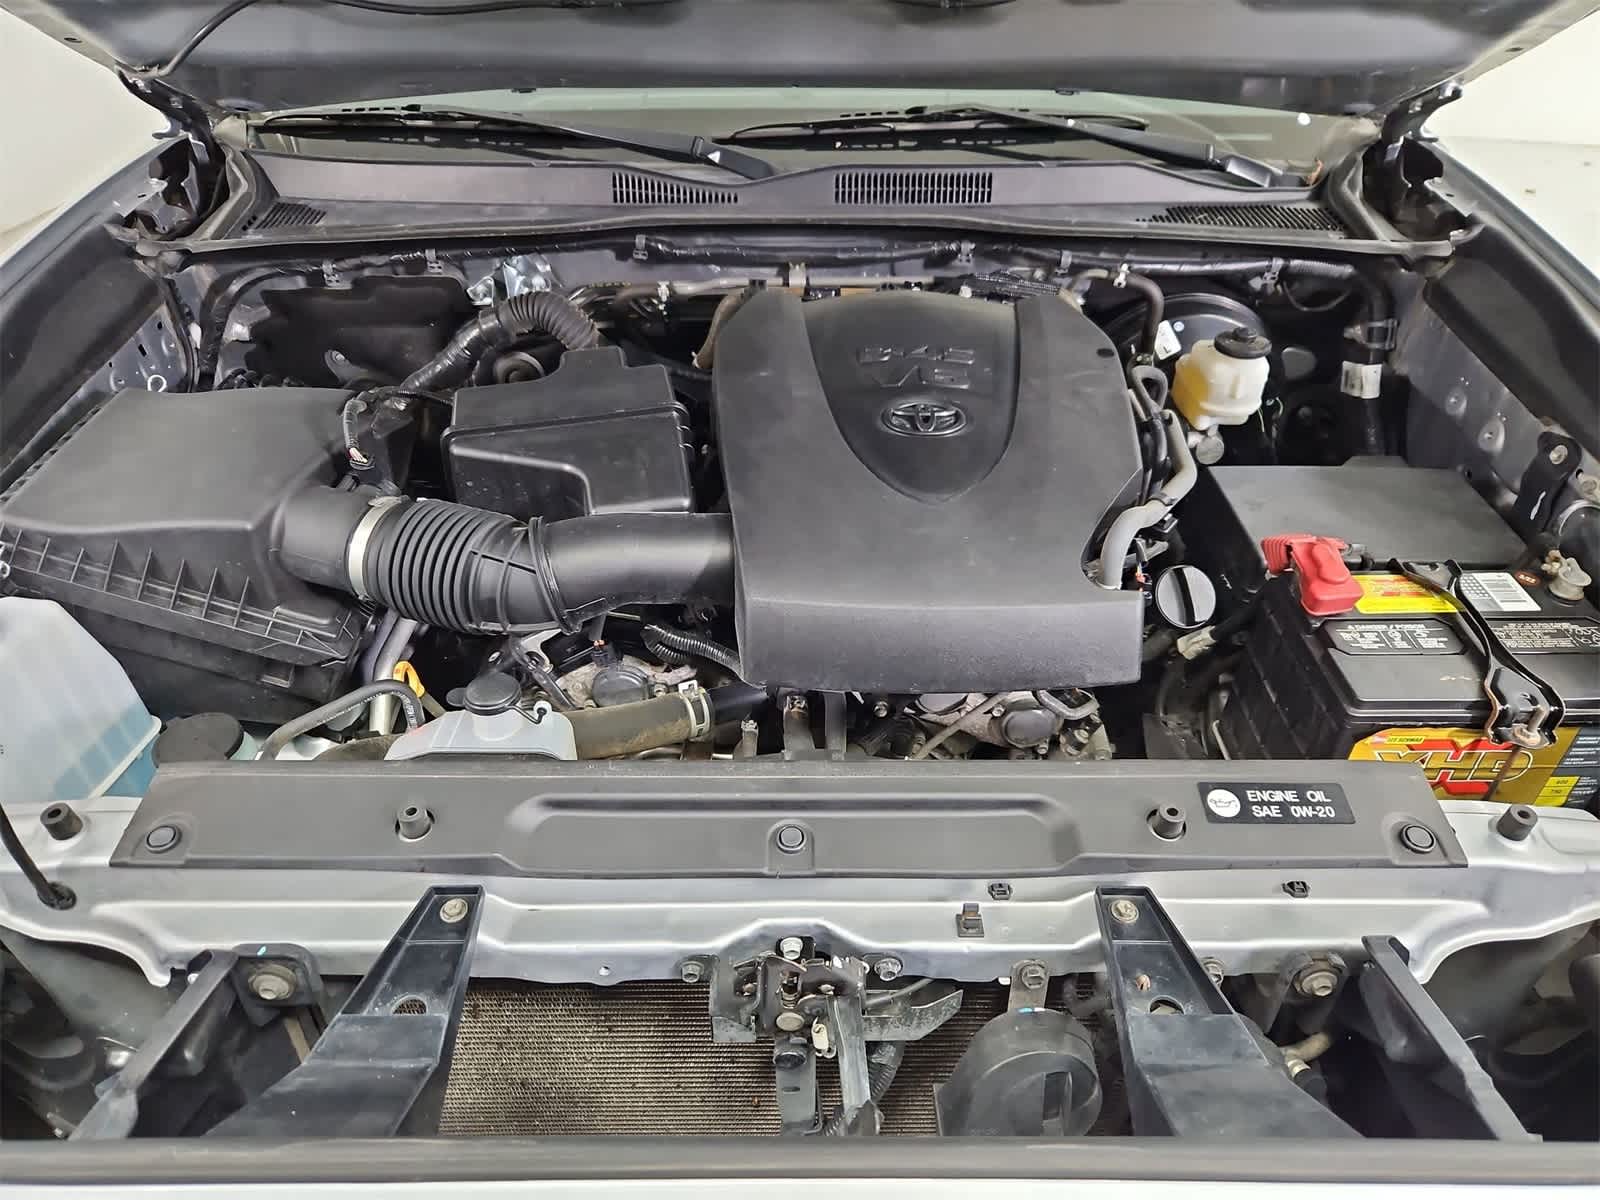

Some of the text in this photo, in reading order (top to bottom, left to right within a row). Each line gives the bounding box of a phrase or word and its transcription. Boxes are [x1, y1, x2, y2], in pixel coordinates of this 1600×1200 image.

[1246, 790, 1332, 803] ENGINE OIL
[1252, 805, 1336, 818] SAE 0W-20
